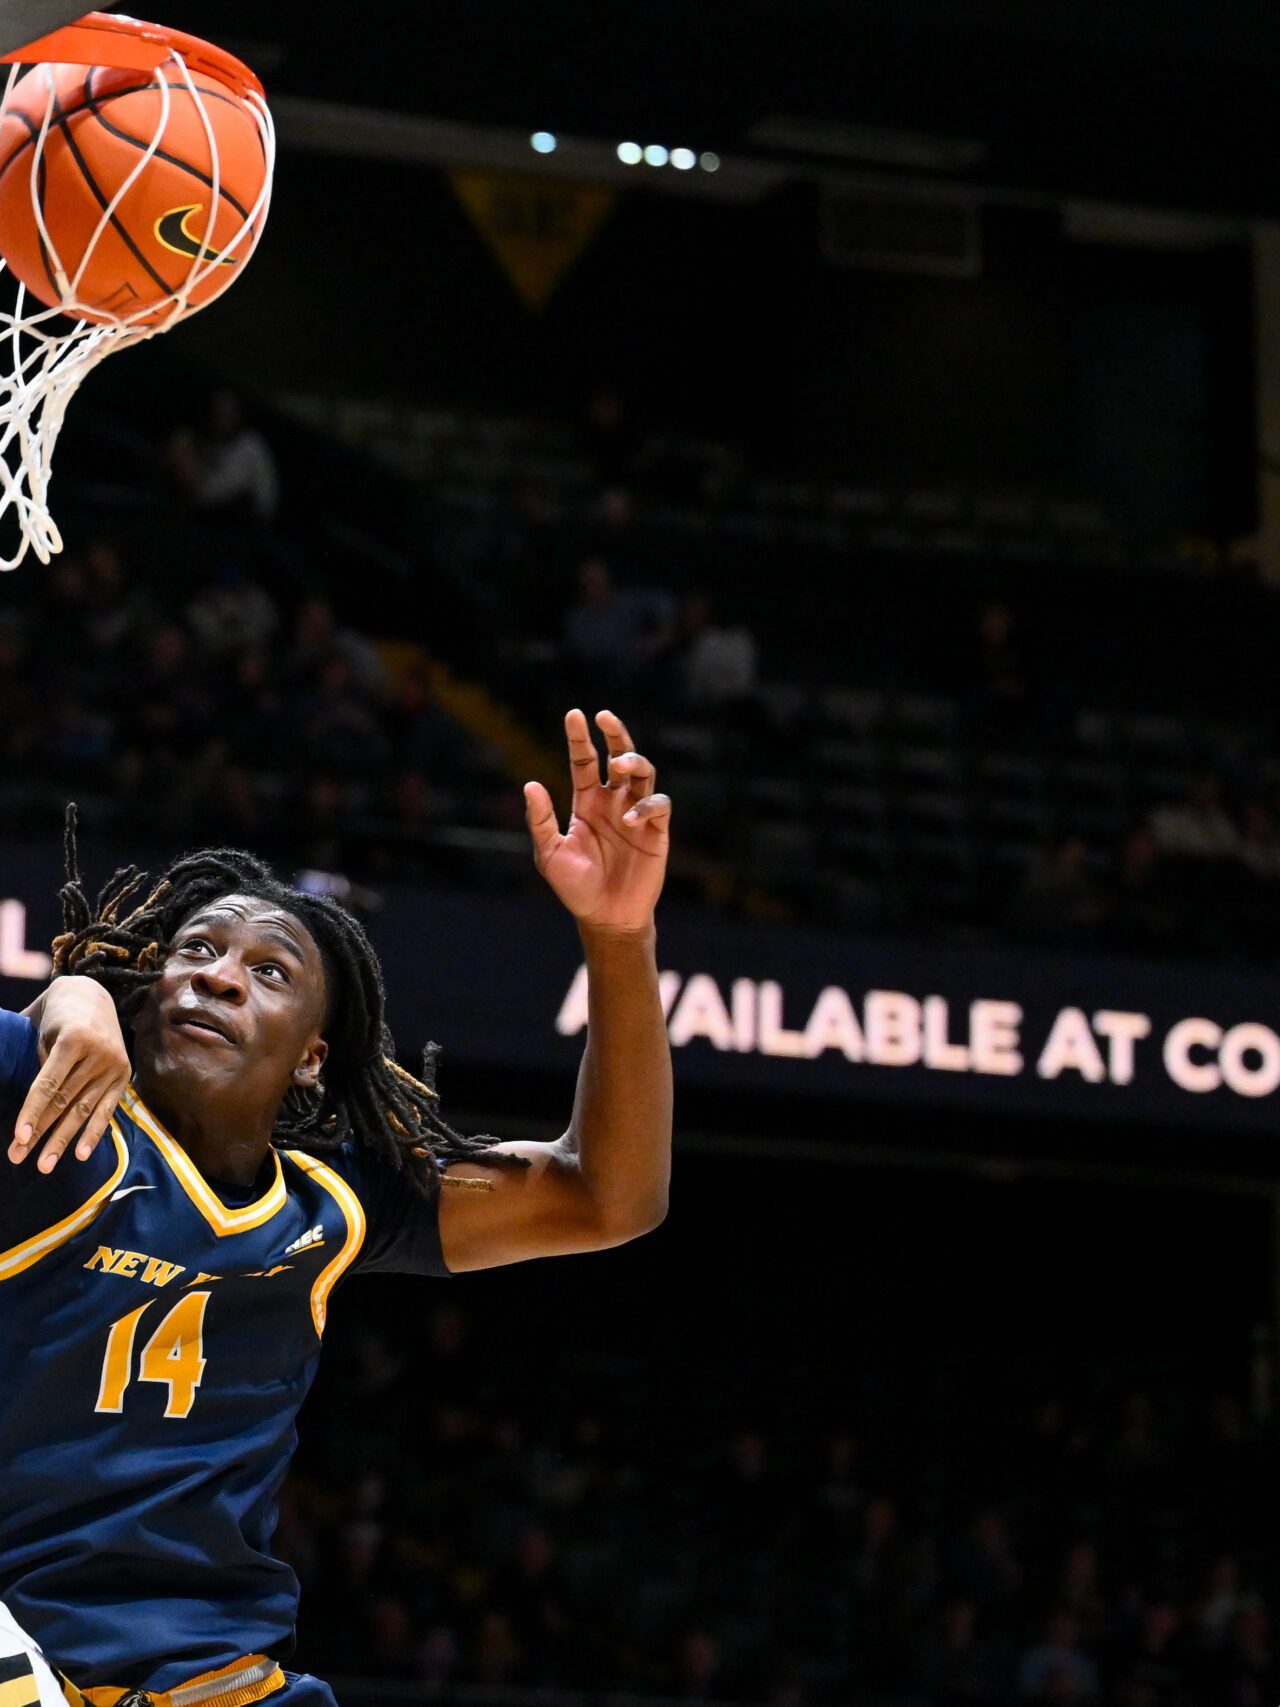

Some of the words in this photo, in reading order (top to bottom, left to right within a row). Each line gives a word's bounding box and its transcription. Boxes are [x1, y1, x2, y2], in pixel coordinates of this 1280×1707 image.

[1036, 1006, 1152, 1086] AT
[1162, 1016, 1280, 1098] CO
[83, 1245, 187, 1288] NEW
[94, 1291, 212, 1419] 14
